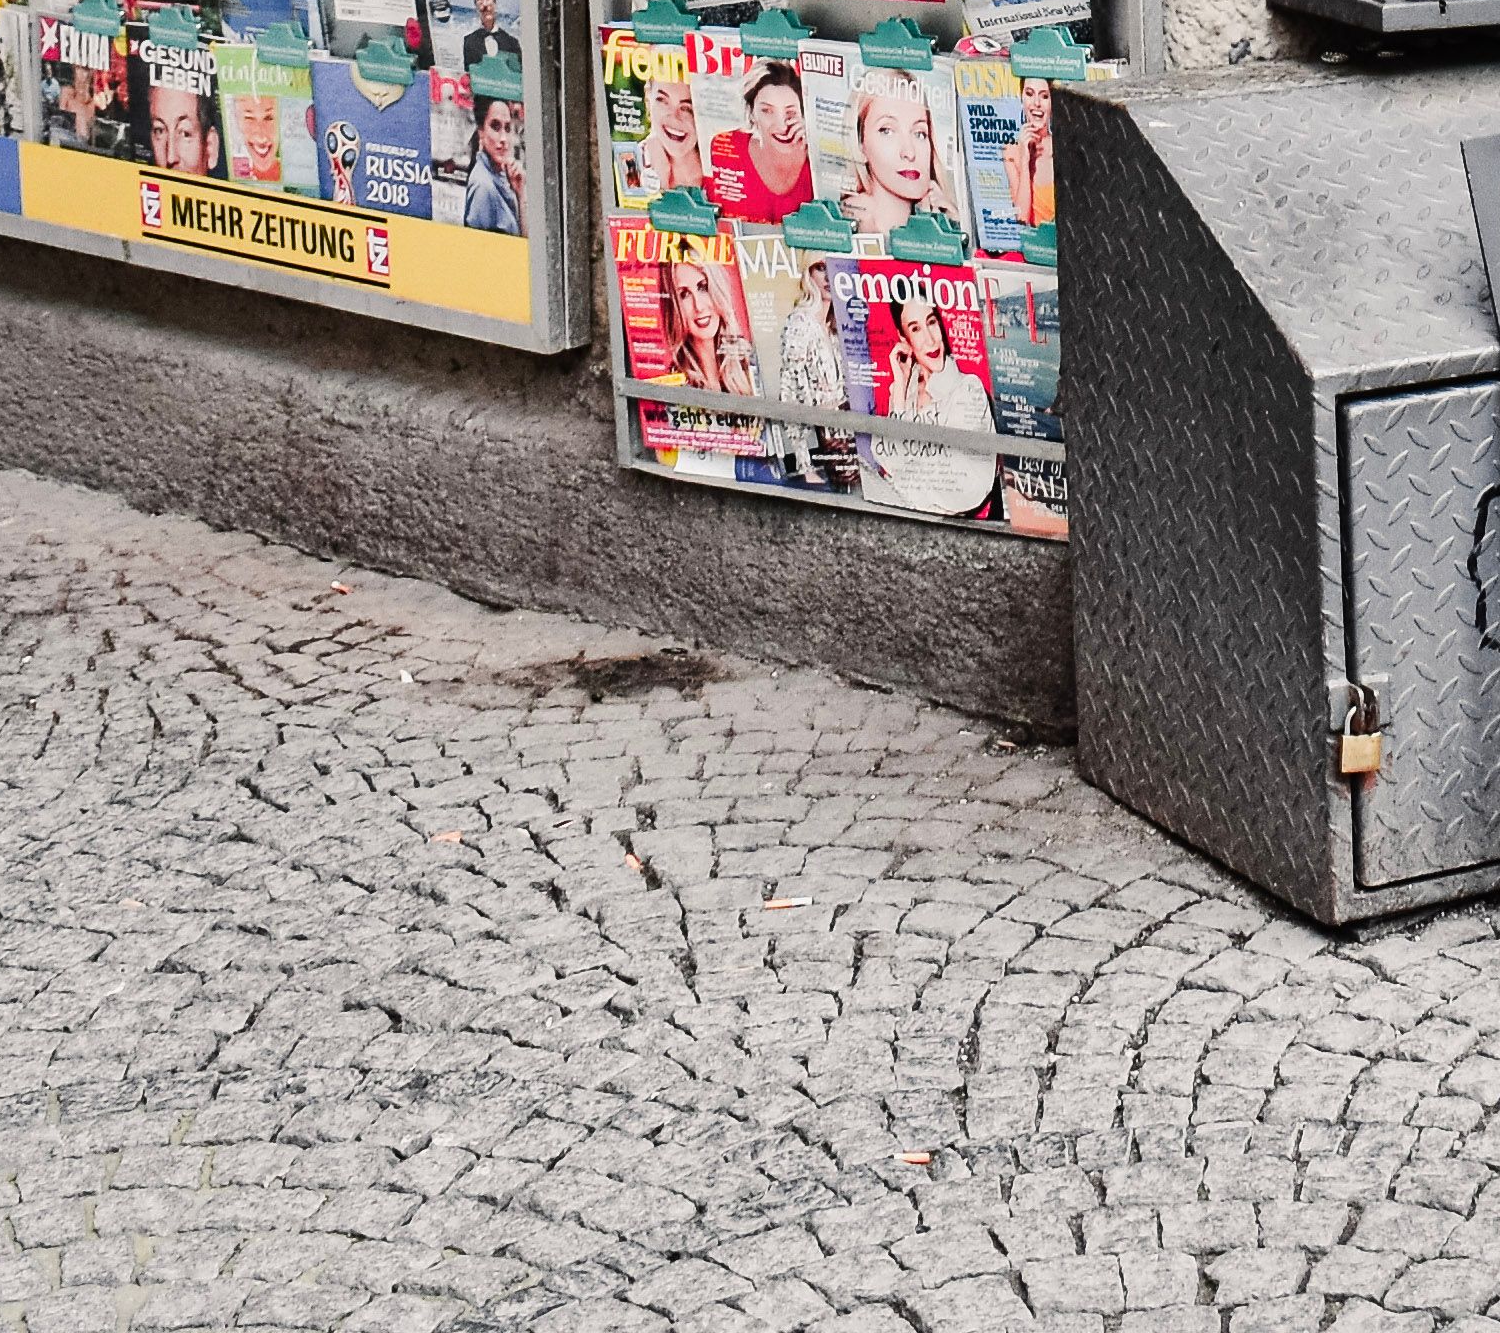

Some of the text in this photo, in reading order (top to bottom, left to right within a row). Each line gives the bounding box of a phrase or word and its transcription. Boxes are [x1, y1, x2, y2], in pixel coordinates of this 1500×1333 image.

[976, 8, 1041, 29] International
[139, 39, 216, 76] GESUND
[802, 54, 843, 75] BUNTE
[150, 64, 212, 97] LEBEN
[967, 105, 997, 117] WILD.
[968, 118, 1019, 132] SPONTAN.
[972, 131, 1018, 144] TABULOS.
[366, 155, 432, 185] RUSSIA
[366, 180, 409, 207] 2018
[140, 181, 390, 275] tz MEHR ZEITUNG tz
[834, 265, 980, 311] emotion
